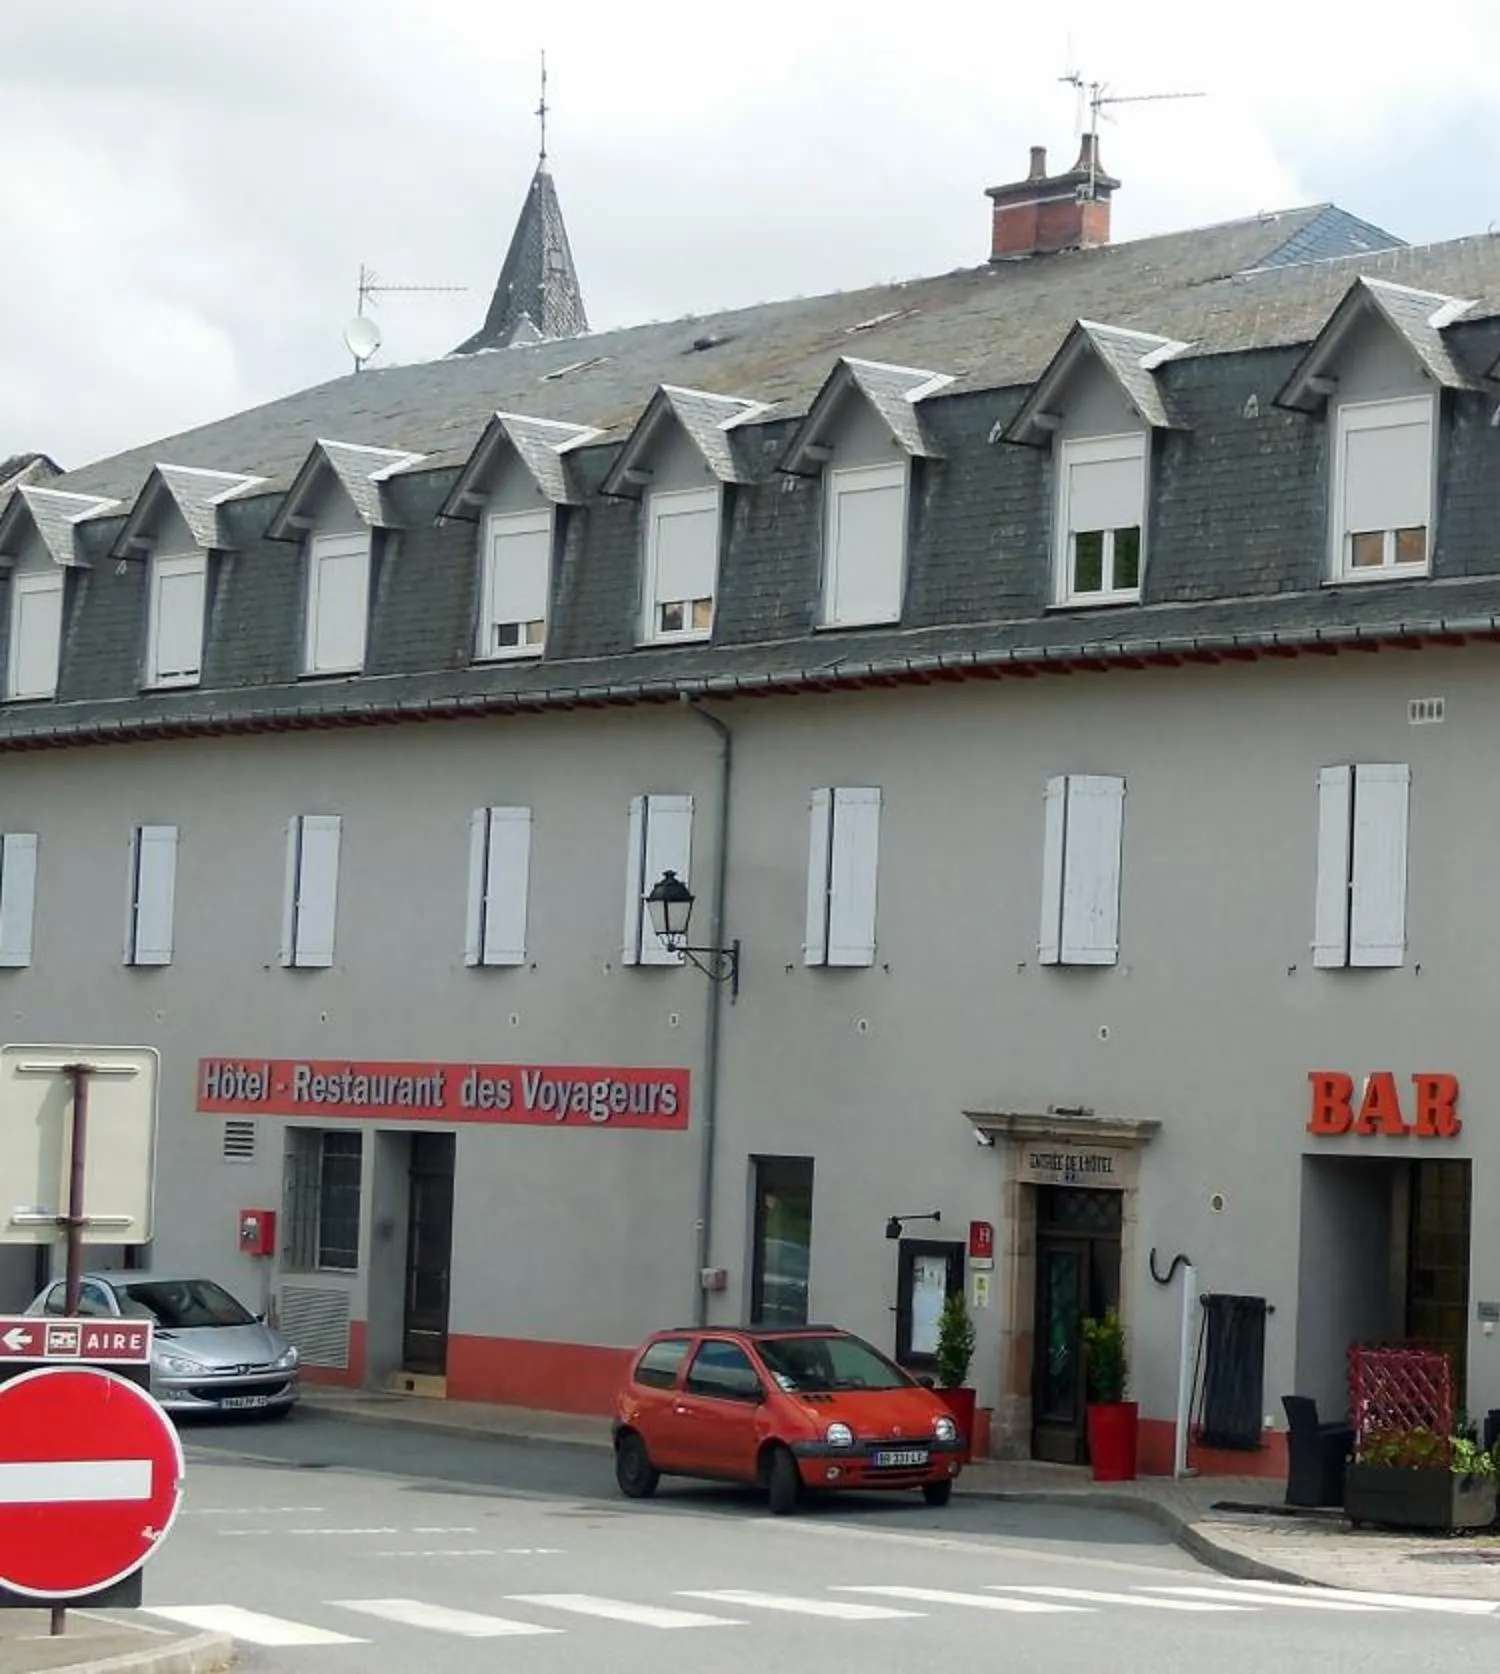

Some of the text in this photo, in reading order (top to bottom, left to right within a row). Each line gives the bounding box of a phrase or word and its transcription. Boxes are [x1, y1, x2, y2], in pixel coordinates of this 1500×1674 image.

[204, 1062, 273, 1101] Hôtel
[293, 1064, 447, 1108] Restaurant
[460, 1068, 513, 1109] des
[520, 1069, 679, 1123] Voyageurs
[1305, 1071, 1462, 1136] BAR
[86, 1332, 142, 1350] AIRE
